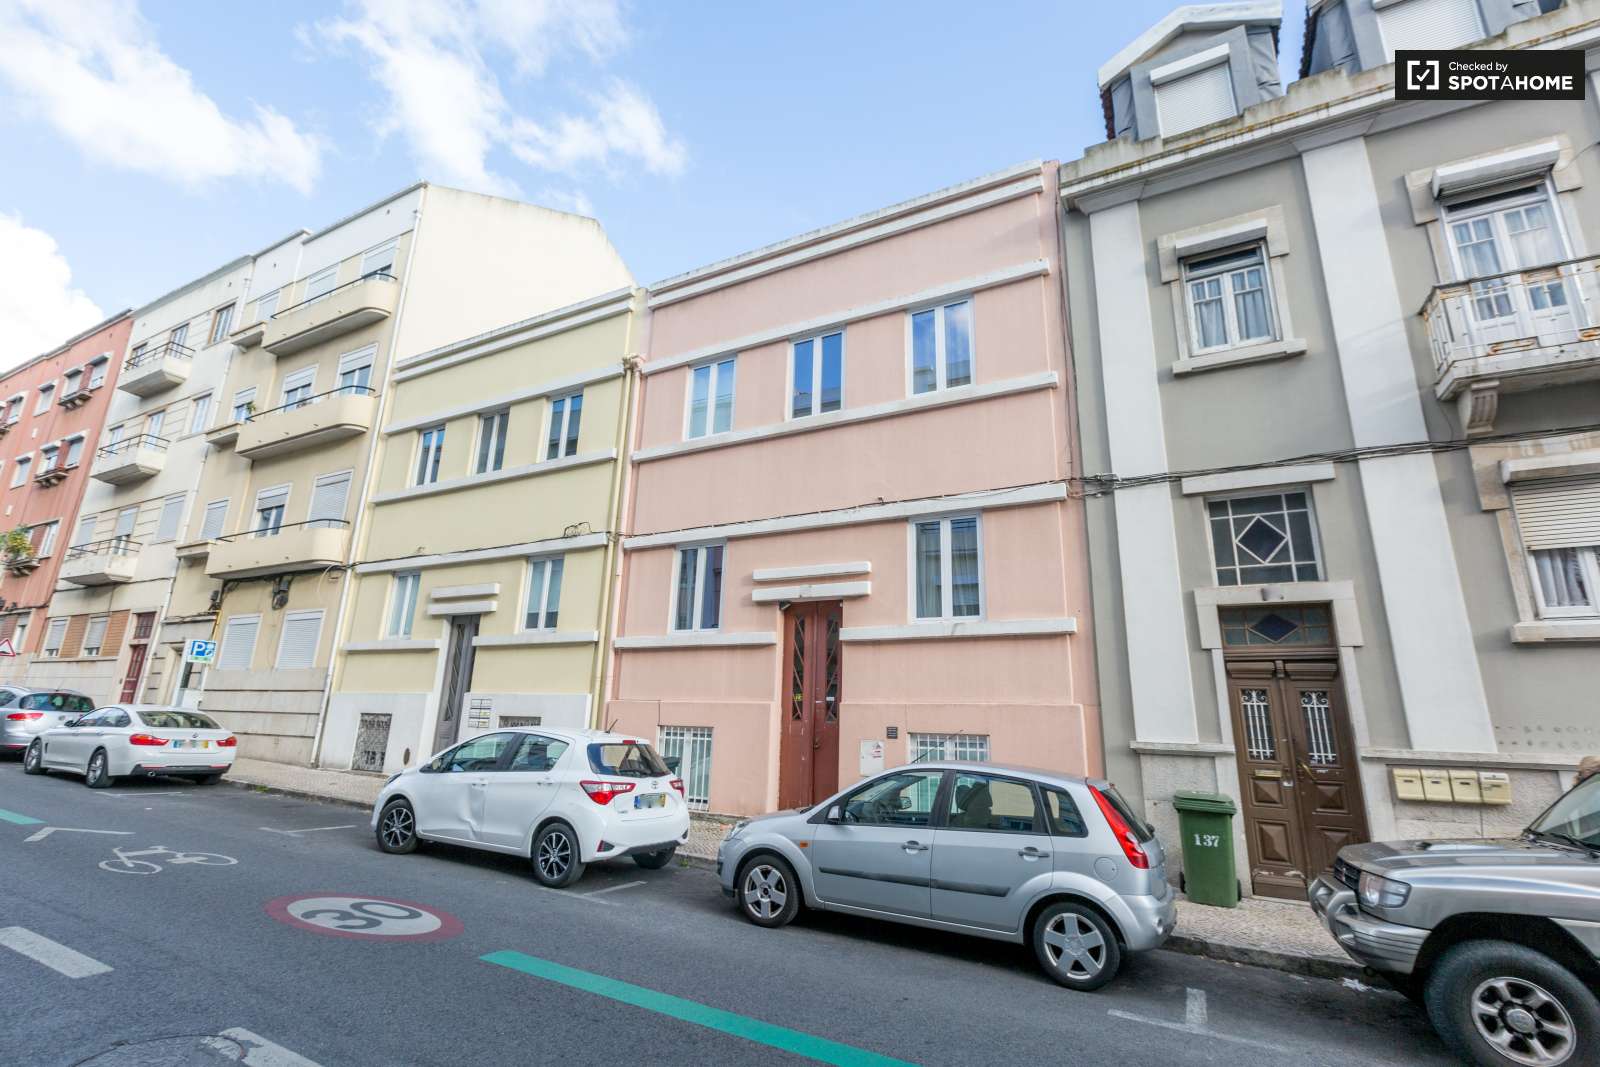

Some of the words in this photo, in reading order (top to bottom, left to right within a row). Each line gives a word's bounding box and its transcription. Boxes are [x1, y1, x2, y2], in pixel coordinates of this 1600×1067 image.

[193, 641, 206, 656] P
[1193, 833, 1220, 848] 137
[300, 901, 423, 930] 30
